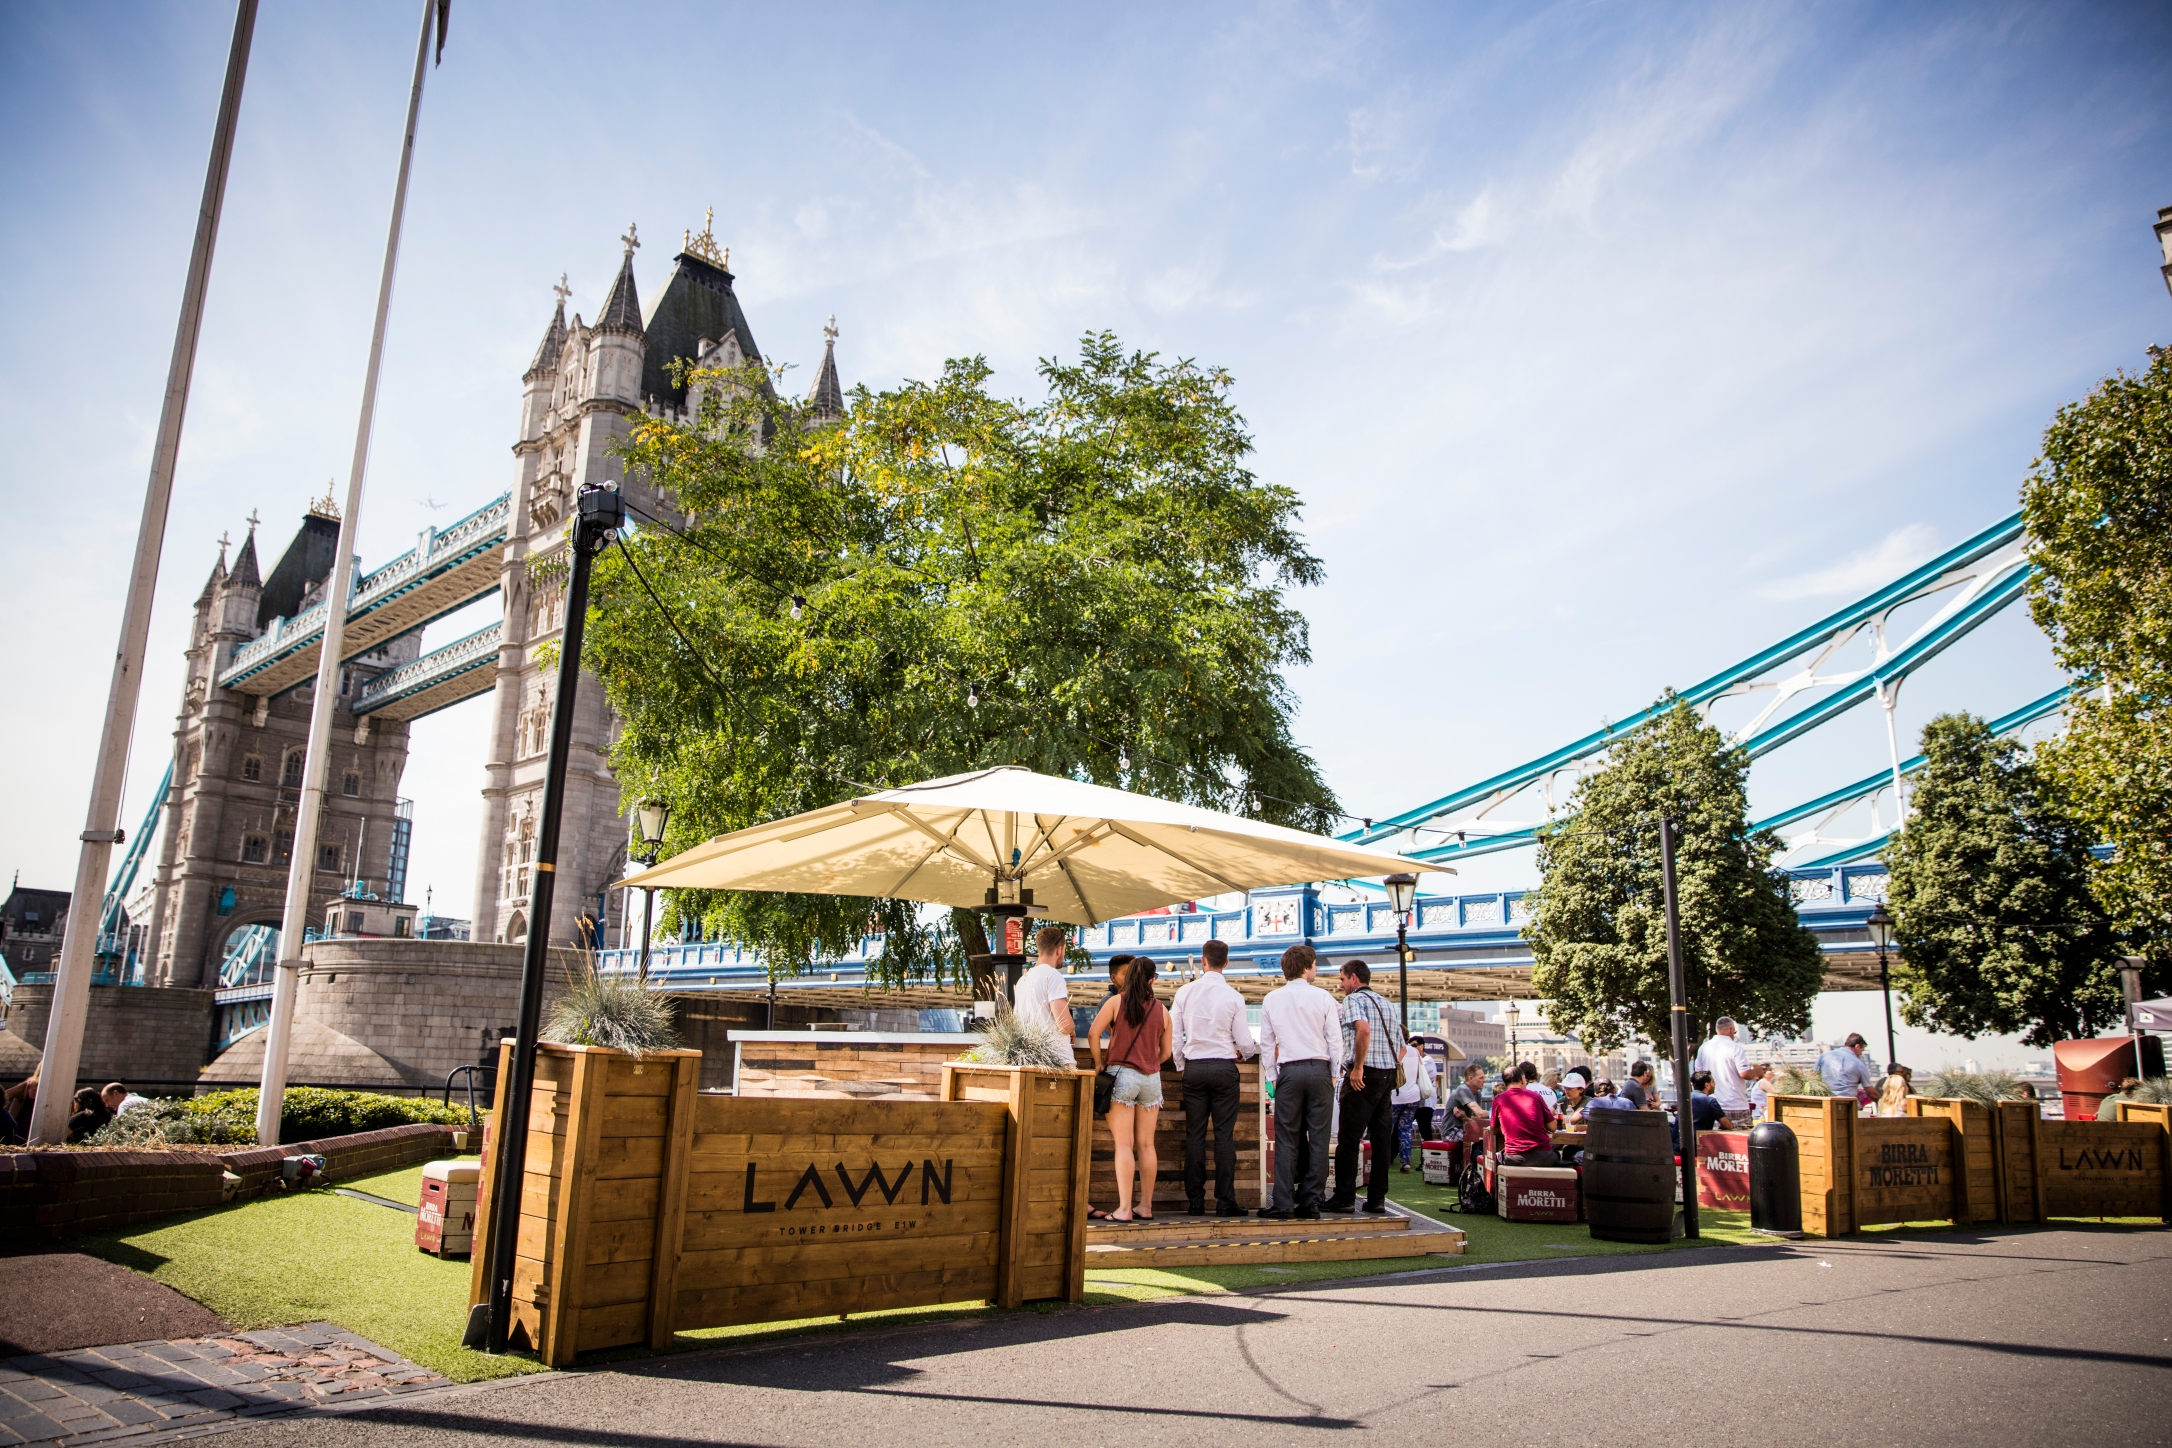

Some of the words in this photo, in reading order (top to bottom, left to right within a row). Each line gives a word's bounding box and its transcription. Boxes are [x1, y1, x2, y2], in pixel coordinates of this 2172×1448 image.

[1719, 1152, 1748, 1161] BIRRA
[1881, 1144, 1928, 1164] BIRRA
[2059, 1148, 2143, 1171] LAWN
[1425, 1162, 1448, 1172] MORETTI
[1707, 1156, 1750, 1172] MORET
[1869, 1165, 1939, 1187] MORETTI
[743, 1159, 954, 1214] LAWN
[1528, 1189, 1556, 1198] BIRRA
[1517, 1194, 1566, 1208] MORETTI
[779, 1225, 826, 1236] TOWER
[833, 1221, 882, 1233] BRIDGE
[894, 1220, 917, 1230] E1W
